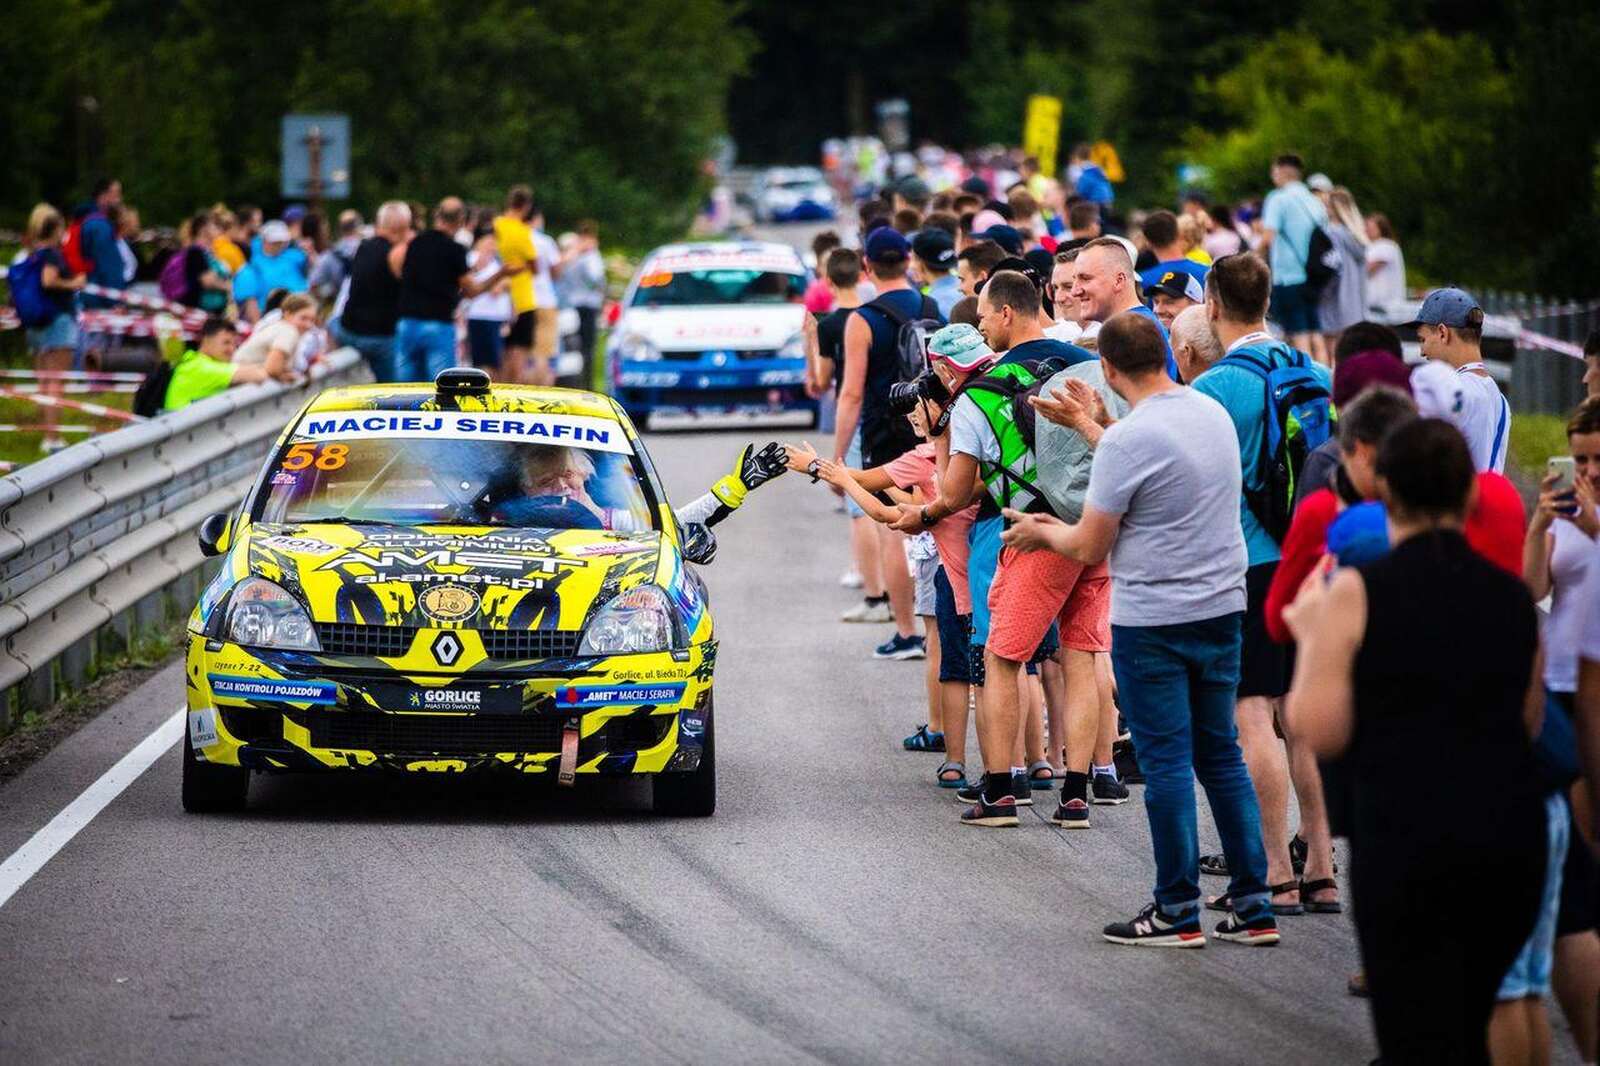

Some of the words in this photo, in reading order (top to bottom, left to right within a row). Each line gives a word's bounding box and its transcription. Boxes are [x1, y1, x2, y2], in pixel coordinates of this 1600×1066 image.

[1161, 272, 1174, 284] P
[308, 417, 443, 435] MACIEJ
[456, 418, 610, 444] SERAFIN
[281, 443, 351, 471] 58
[368, 534, 545, 544] ODLEWNIA
[361, 541, 552, 553] ALUMINIUM
[315, 551, 586, 573] AMET
[355, 573, 543, 589] al-amet.pl
[234, 683, 273, 694] KONTROLI
[275, 686, 322, 697] POJAZDÓW
[425, 690, 480, 702] GORLICE
[618, 690, 648, 700] MACIEJ
[648, 689, 675, 699] SERAFIN
